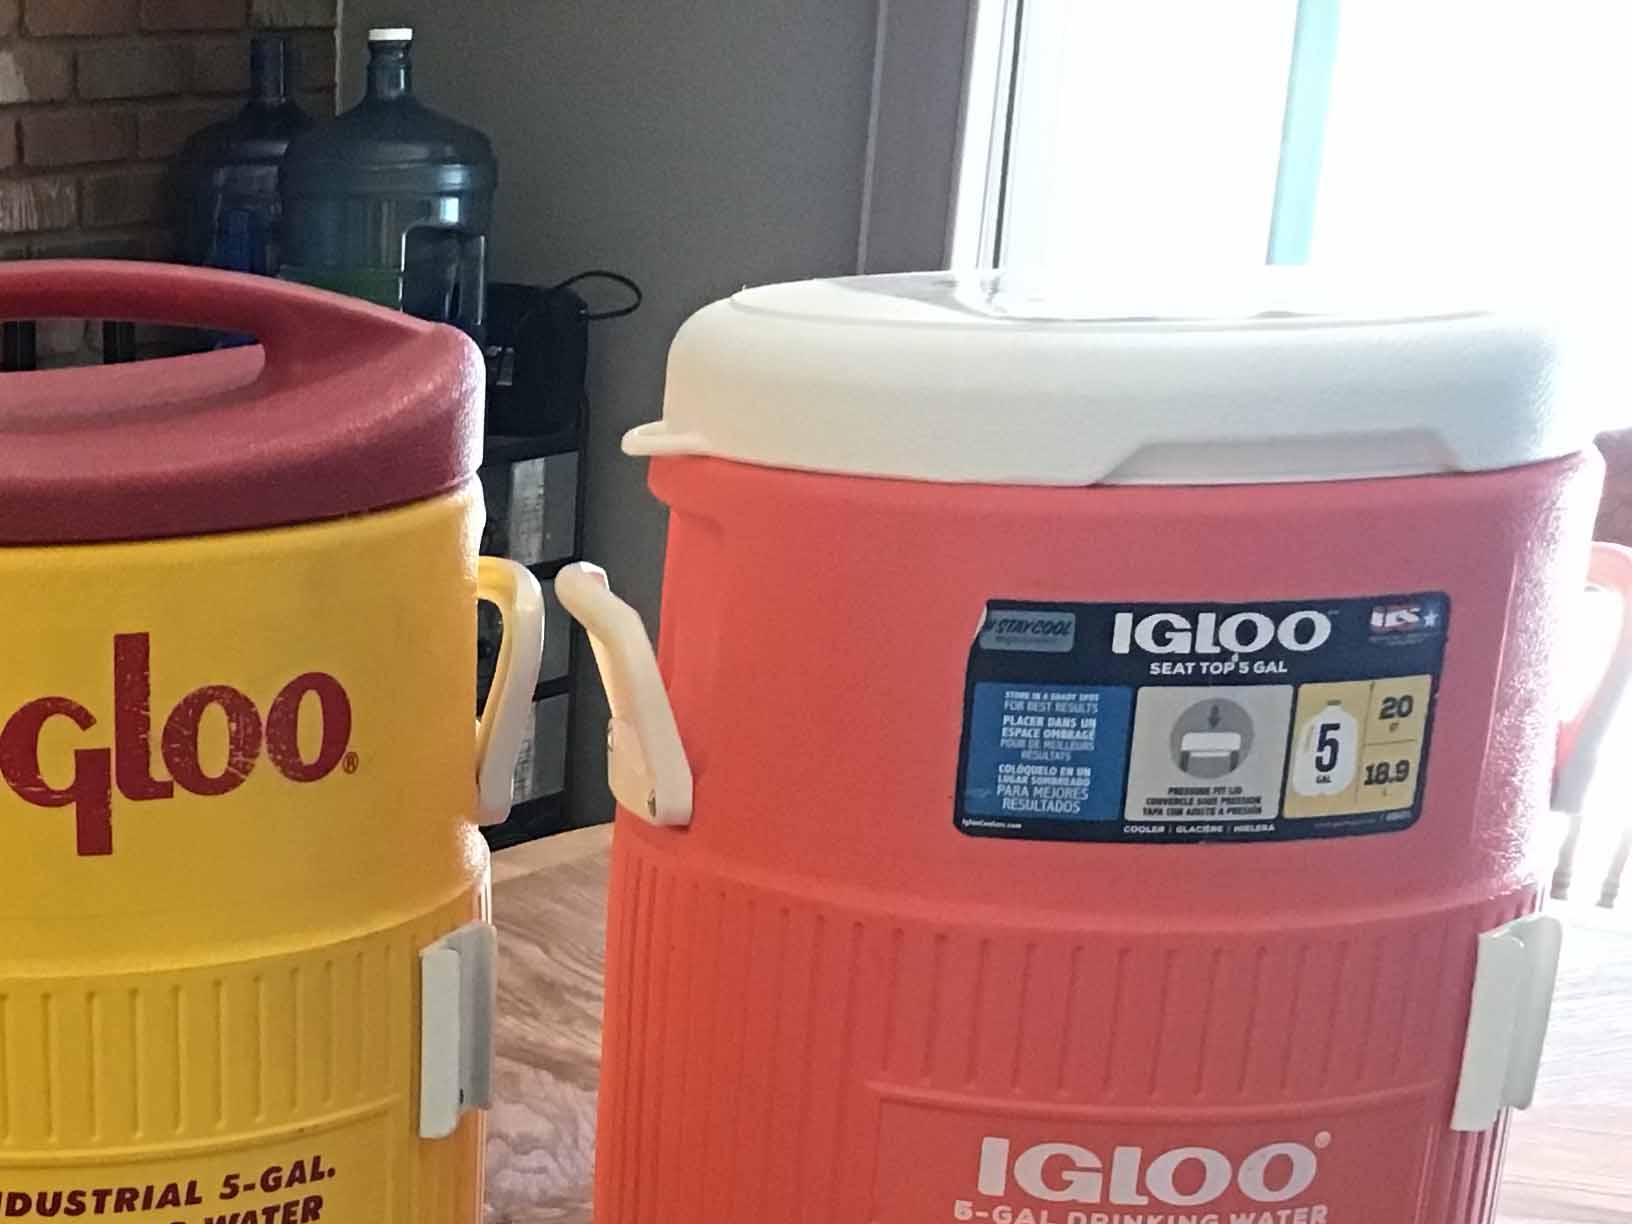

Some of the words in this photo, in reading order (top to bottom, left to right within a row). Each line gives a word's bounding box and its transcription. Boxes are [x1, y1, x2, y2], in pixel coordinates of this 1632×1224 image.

[1112, 610, 1332, 654] IGLOO
[1149, 662, 1196, 675] SEAT
[1200, 661, 1235, 675] TOP
[1238, 660, 1249, 674] 5
[1253, 660, 1288, 674] GAL
[1379, 695, 1414, 720] 20
[1314, 723, 1341, 773] 5
[1364, 759, 1410, 786] 18.9
[996, 784, 1029, 797] PARA
[1032, 786, 1089, 801] MEJORES
[1001, 798, 1081, 814] RESULTADOS
[218, 1155, 336, 1200] 5-GAL.
[977, 1137, 1318, 1206] IGLOO
